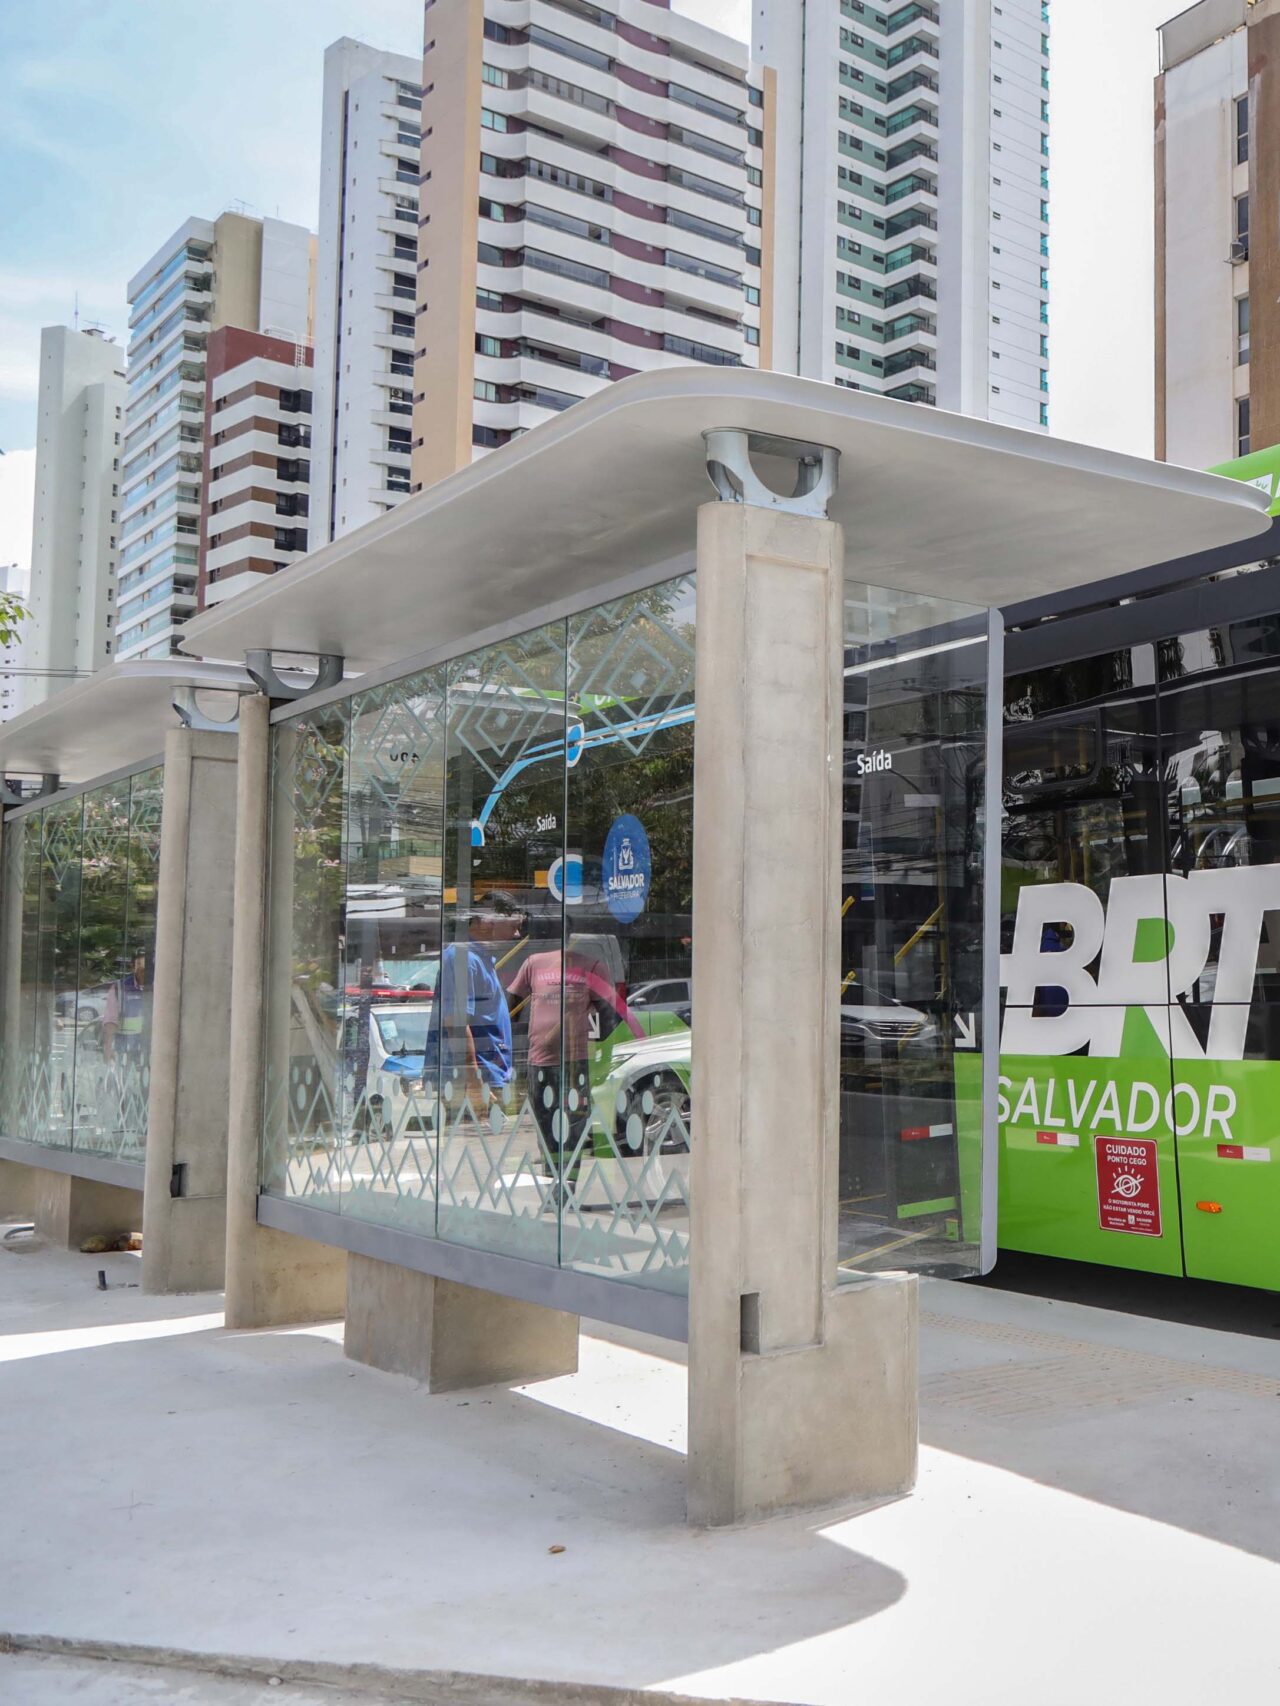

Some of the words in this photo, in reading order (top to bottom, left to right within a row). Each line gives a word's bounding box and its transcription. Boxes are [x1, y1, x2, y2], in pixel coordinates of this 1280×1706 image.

[857, 749, 892, 775] Saída
[608, 873, 645, 890] SALVADOR
[998, 1076, 1237, 1139] SALVADOR
[1105, 1144, 1147, 1156] CUIDADO
[1107, 1155, 1128, 1164] PONTO
[1129, 1157, 1147, 1166] CEGO
